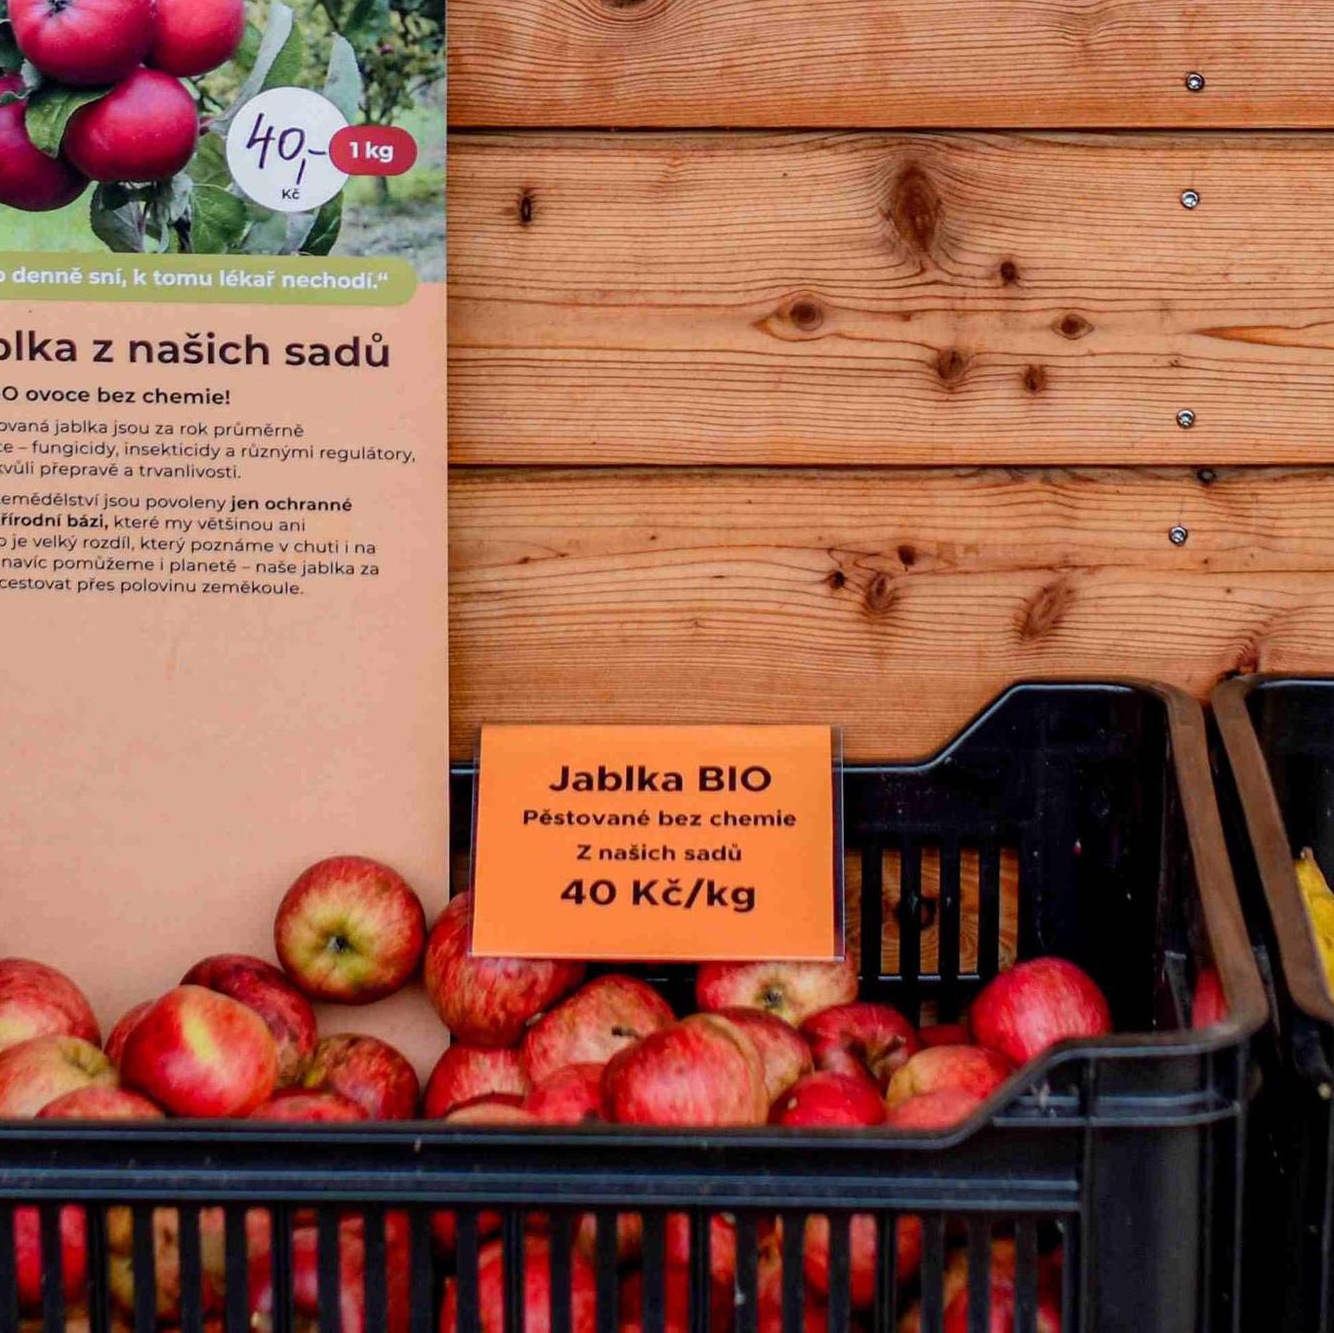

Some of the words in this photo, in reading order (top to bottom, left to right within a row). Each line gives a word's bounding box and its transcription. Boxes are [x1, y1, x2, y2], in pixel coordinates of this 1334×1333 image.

[349, 141, 359, 159] 1
[365, 141, 394, 163] kg
[281, 188, 301, 200] Kč
[10, 266, 84, 285] denně
[87, 267, 127, 288] sní,
[132, 267, 147, 286] k
[152, 270, 213, 287] tomu
[218, 269, 276, 288] lékař
[281, 271, 389, 290] nechodí.“
[92, 339, 115, 363] z
[129, 331, 270, 366] našich
[284, 331, 390, 368] sadů
[25, 389, 91, 403] ovoce
[97, 386, 137, 404] bez
[142, 387, 231, 406] chemie!
[53, 418, 108, 437] jablka
[111, 419, 150, 438] jsou
[154, 423, 174, 436] za
[179, 422, 209, 436] rok
[213, 421, 305, 439] průměrně
[31, 439, 120, 459] fungicidy,
[123, 441, 221, 461] insekticidy
[225, 446, 236, 458] a
[241, 442, 314, 463] různými
[319, 445, 416, 465] regulátory,
[39, 461, 119, 479] přepravě
[123, 466, 134, 477] a
[138, 463, 242, 479] trvanlivosti.
[102, 492, 140, 511] jsou
[145, 494, 227, 513] povoleny
[228, 494, 260, 514] jen
[264, 496, 353, 512] ochranné
[66, 513, 109, 531] bázi,
[114, 514, 160, 530] které
[164, 518, 193, 534] my
[197, 516, 273, 532] většinou
[278, 518, 306, 533] ani
[10, 532, 28, 551] je
[31, 534, 78, 552] velký
[82, 535, 135, 552] rozdíl,
[140, 535, 186, 554] který
[190, 537, 274, 555] poznáme
[278, 542, 289, 553] v
[293, 539, 339, 554] chuti
[345, 539, 349, 554] i
[354, 543, 376, 555] na
[1, 554, 48, 570] navíc
[53, 555, 155, 572] pomůžeme
[160, 557, 164, 571] i
[169, 557, 237, 575] planetě
[255, 560, 298, 574] naše
[301, 559, 355, 578] jablka
[359, 564, 380, 576] za
[77, 577, 116, 594] přes
[120, 577, 197, 595] polovinu
[201, 580, 305, 596] zeměkoule.
[549, 765, 683, 792] Jablka
[698, 765, 771, 792] BIO
[523, 809, 650, 826] Pěstované
[658, 810, 702, 826] bez
[709, 808, 797, 827] chemie
[577, 844, 592, 860] Z
[599, 843, 676, 861] našich
[684, 842, 742, 862] sadů
[560, 879, 616, 905] 40
[632, 878, 755, 913] Kč/kg
